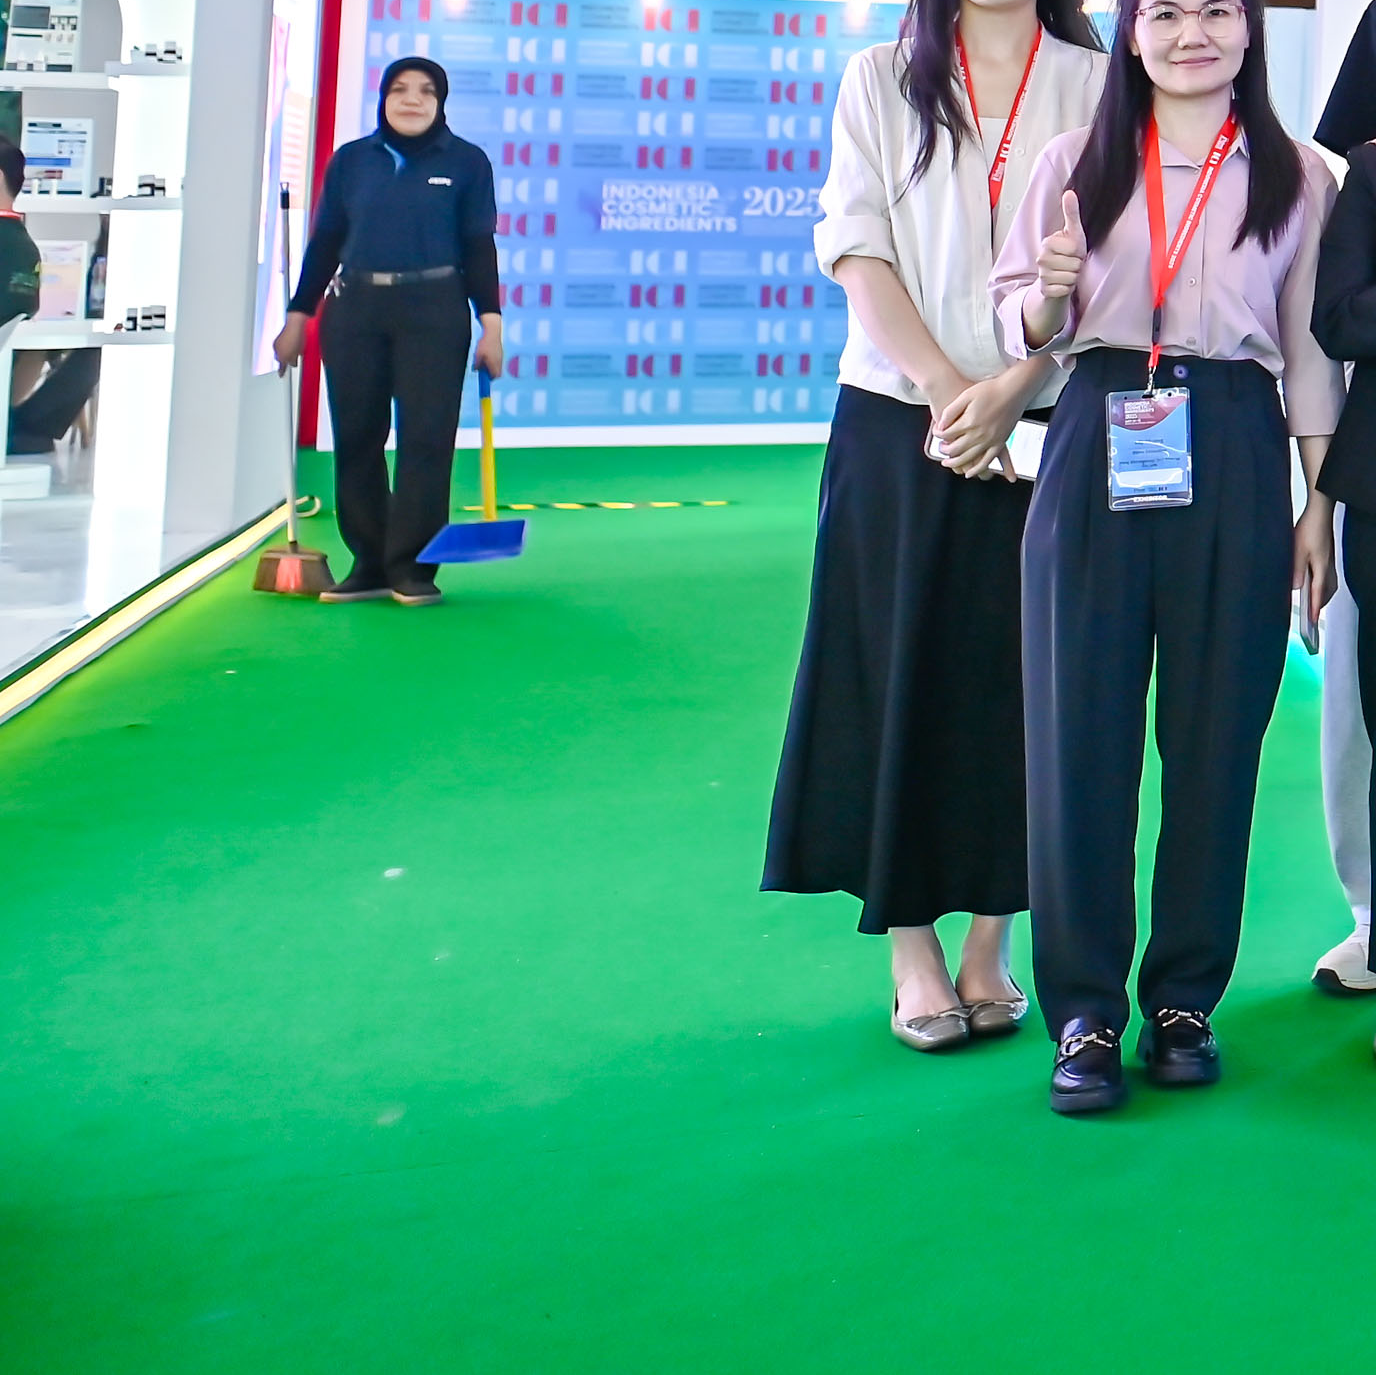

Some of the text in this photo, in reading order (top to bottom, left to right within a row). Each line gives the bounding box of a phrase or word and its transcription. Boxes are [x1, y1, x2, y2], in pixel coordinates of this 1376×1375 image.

[602, 183, 824, 218] INDONESIA 2025
[602, 200, 712, 216] COSMETIC
[600, 216, 737, 232] INGREDIENTS
